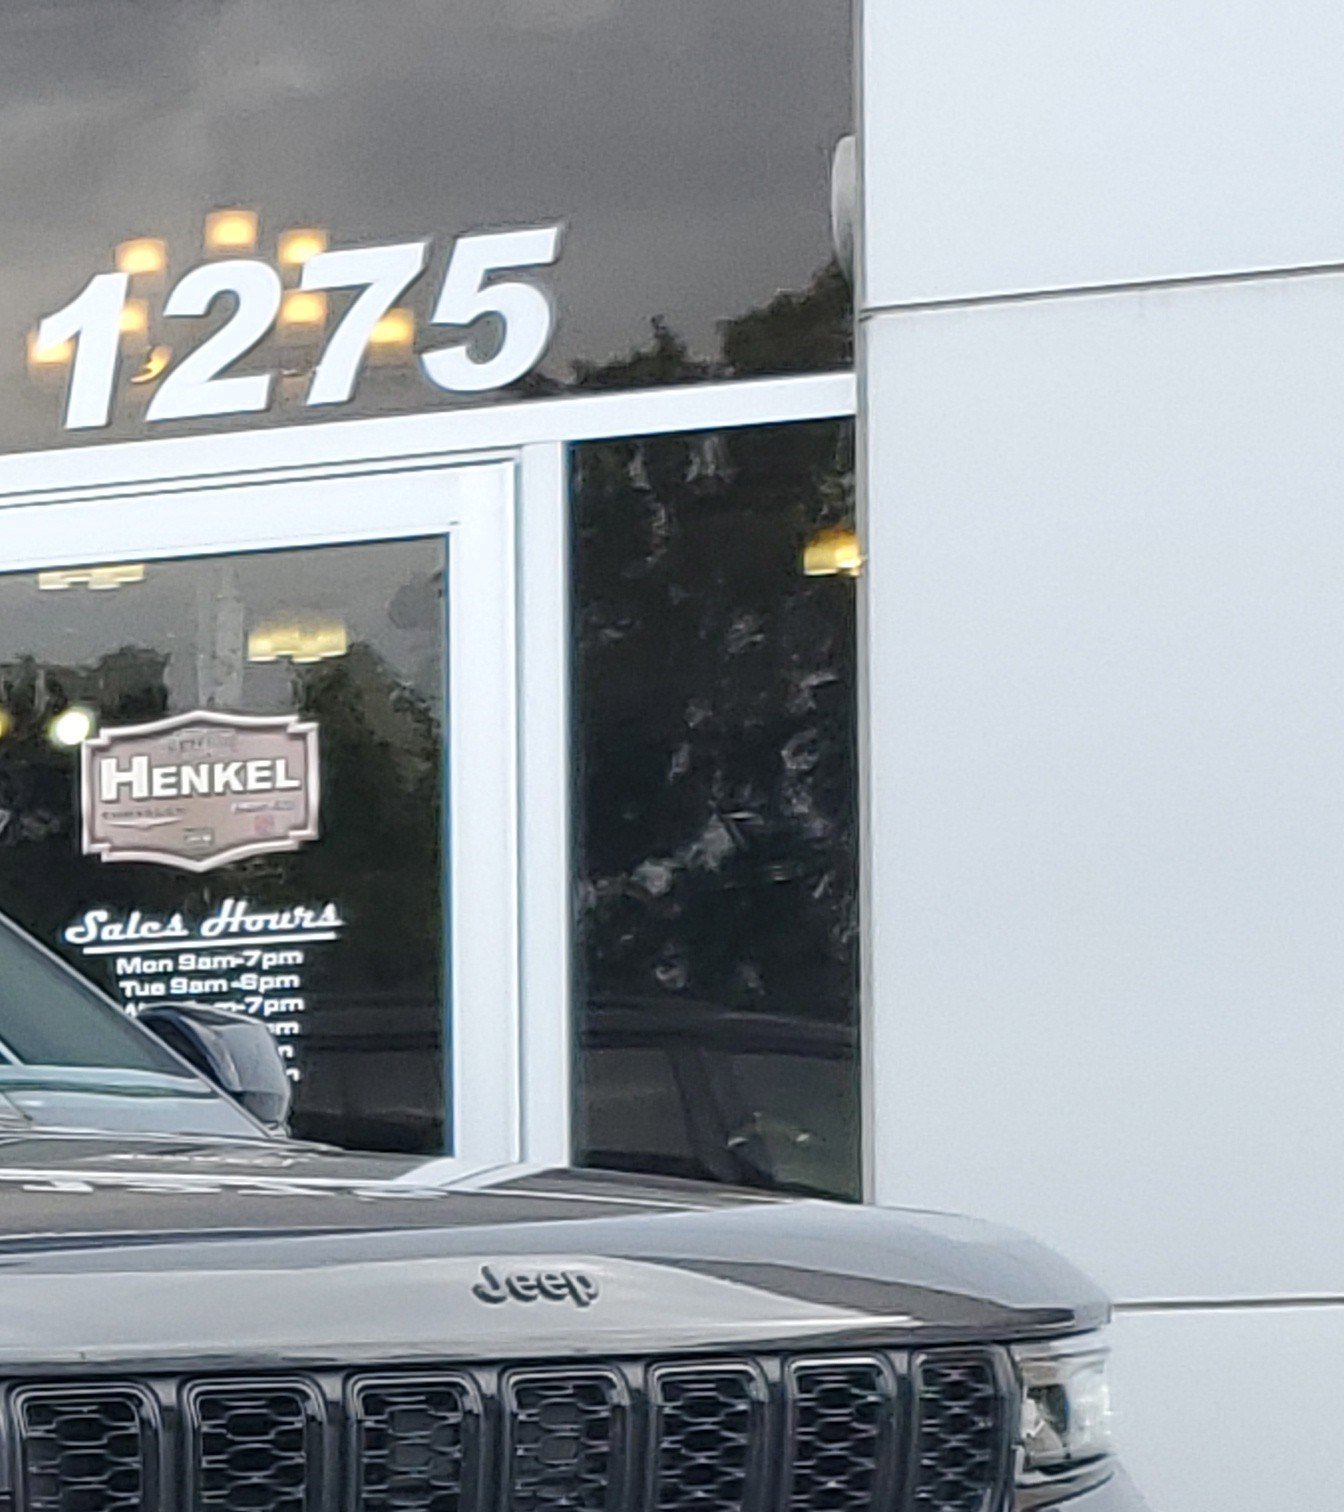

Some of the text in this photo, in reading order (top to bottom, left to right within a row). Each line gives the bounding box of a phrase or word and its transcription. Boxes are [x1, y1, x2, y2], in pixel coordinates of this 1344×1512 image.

[36, 226, 562, 431] 1275
[99, 755, 302, 802] HENKEL
[64, 898, 343, 944] Sales Hours
[115, 950, 304, 975] Mon 9am-7pm
[119, 979, 166, 997] Tue
[470, 1264, 599, 1308] Jeep
